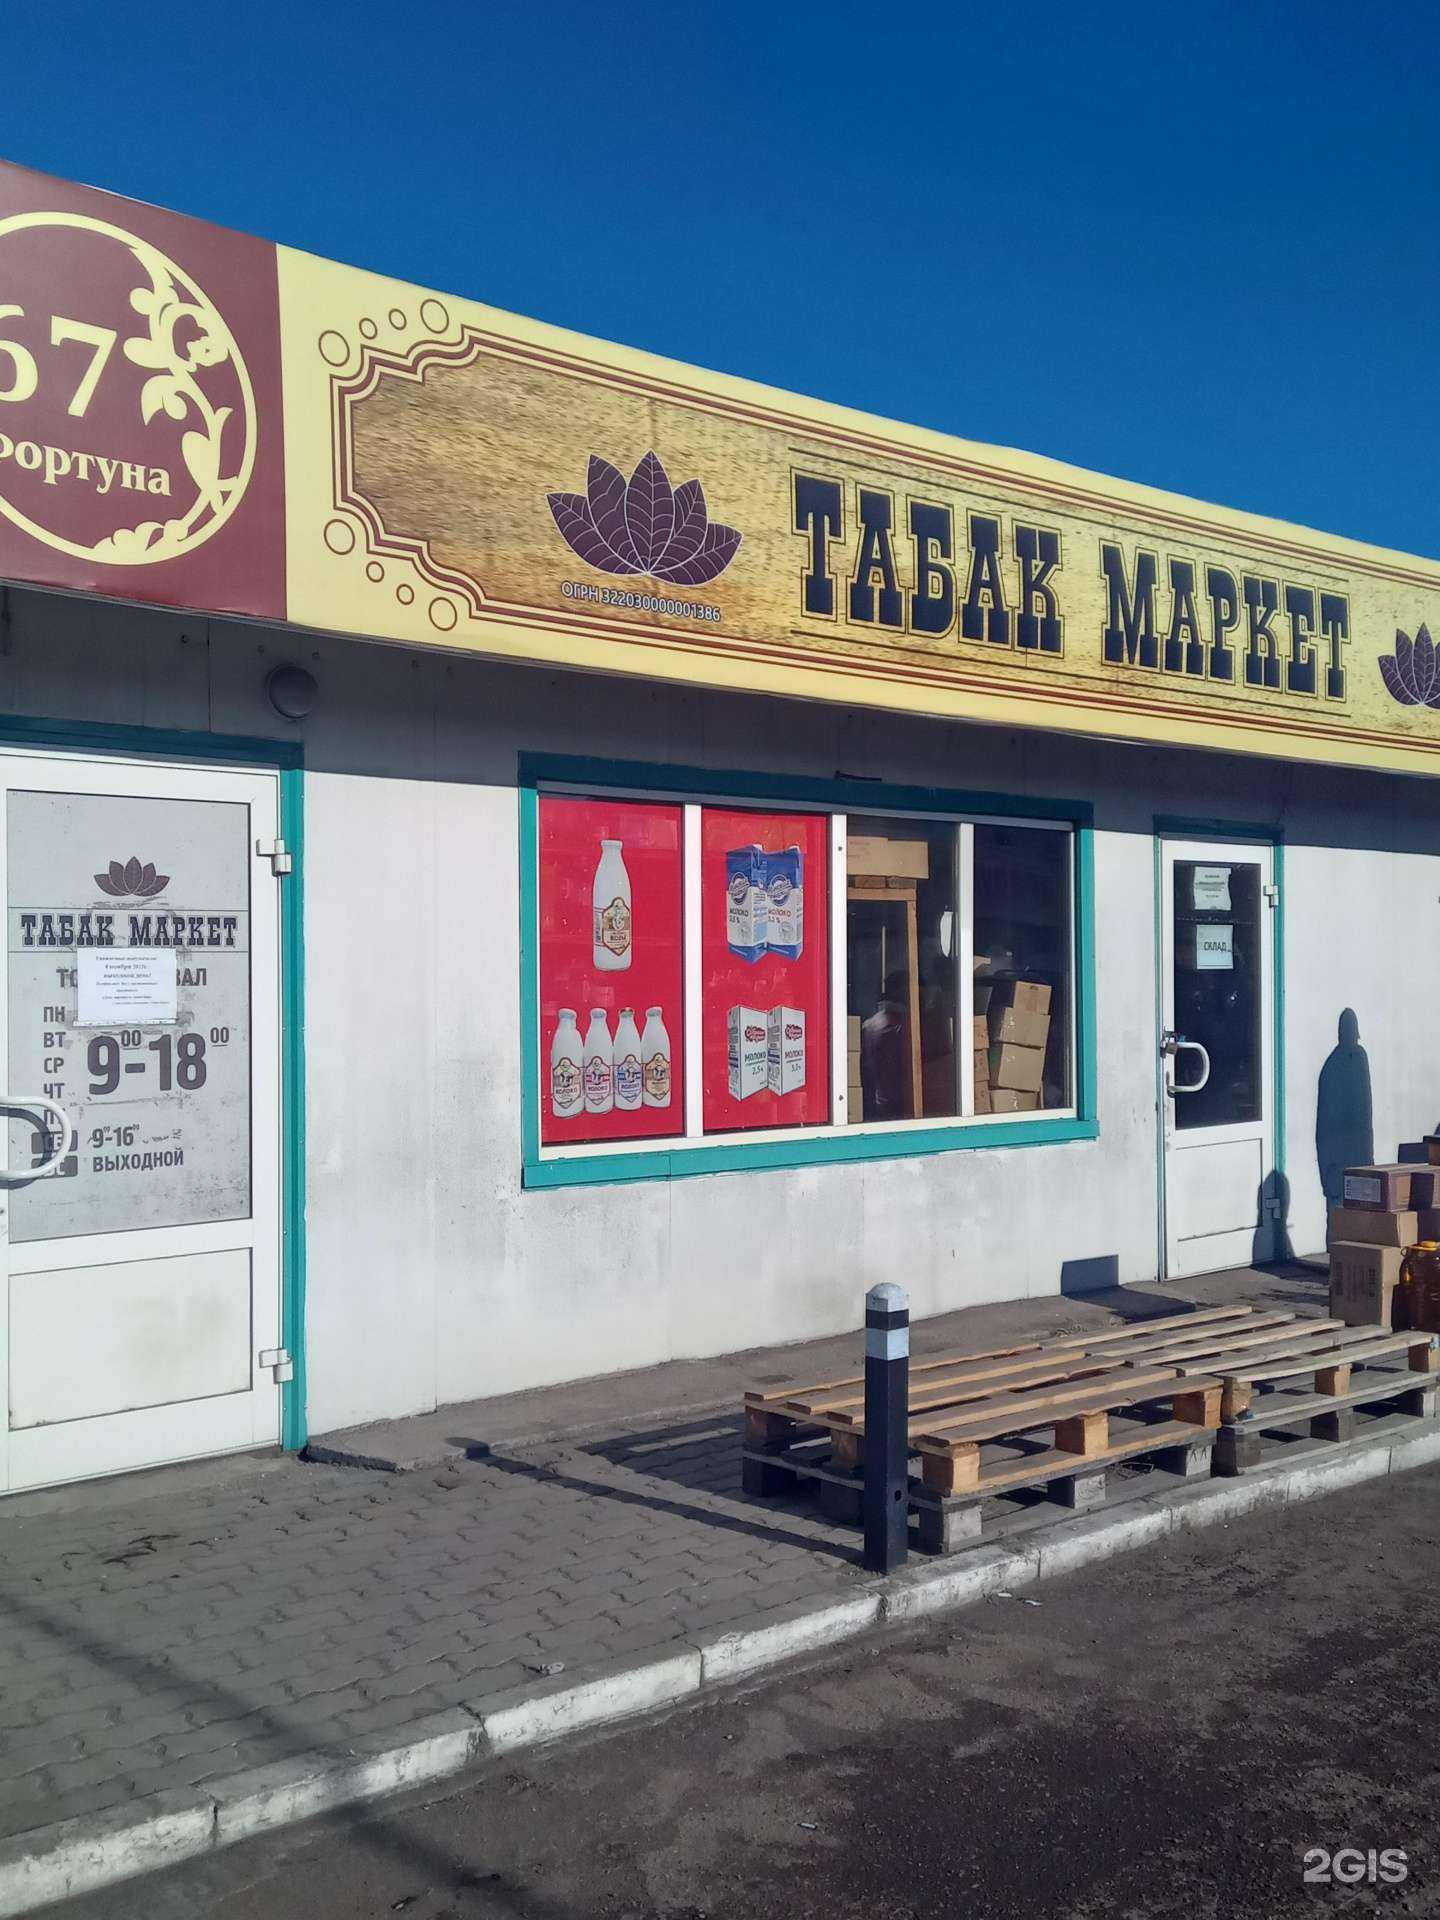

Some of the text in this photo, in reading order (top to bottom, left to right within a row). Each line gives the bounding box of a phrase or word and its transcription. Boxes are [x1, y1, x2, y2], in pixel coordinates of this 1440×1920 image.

[560, 580, 599, 602] ОГРН
[792, 468, 1351, 701] ТАБАК МАРКЕТ
[21, 914, 237, 946] ТАБАК МАРКЕТ
[1203, 941, 1227, 952] СКЛАД
[43, 1006, 66, 1022] ПН
[43, 1031, 67, 1048] ВТ
[43, 1057, 65, 1073] СР
[43, 1083, 65, 1099] ЧТ
[93, 1148, 184, 1173] ВЫХОДНОЙ
